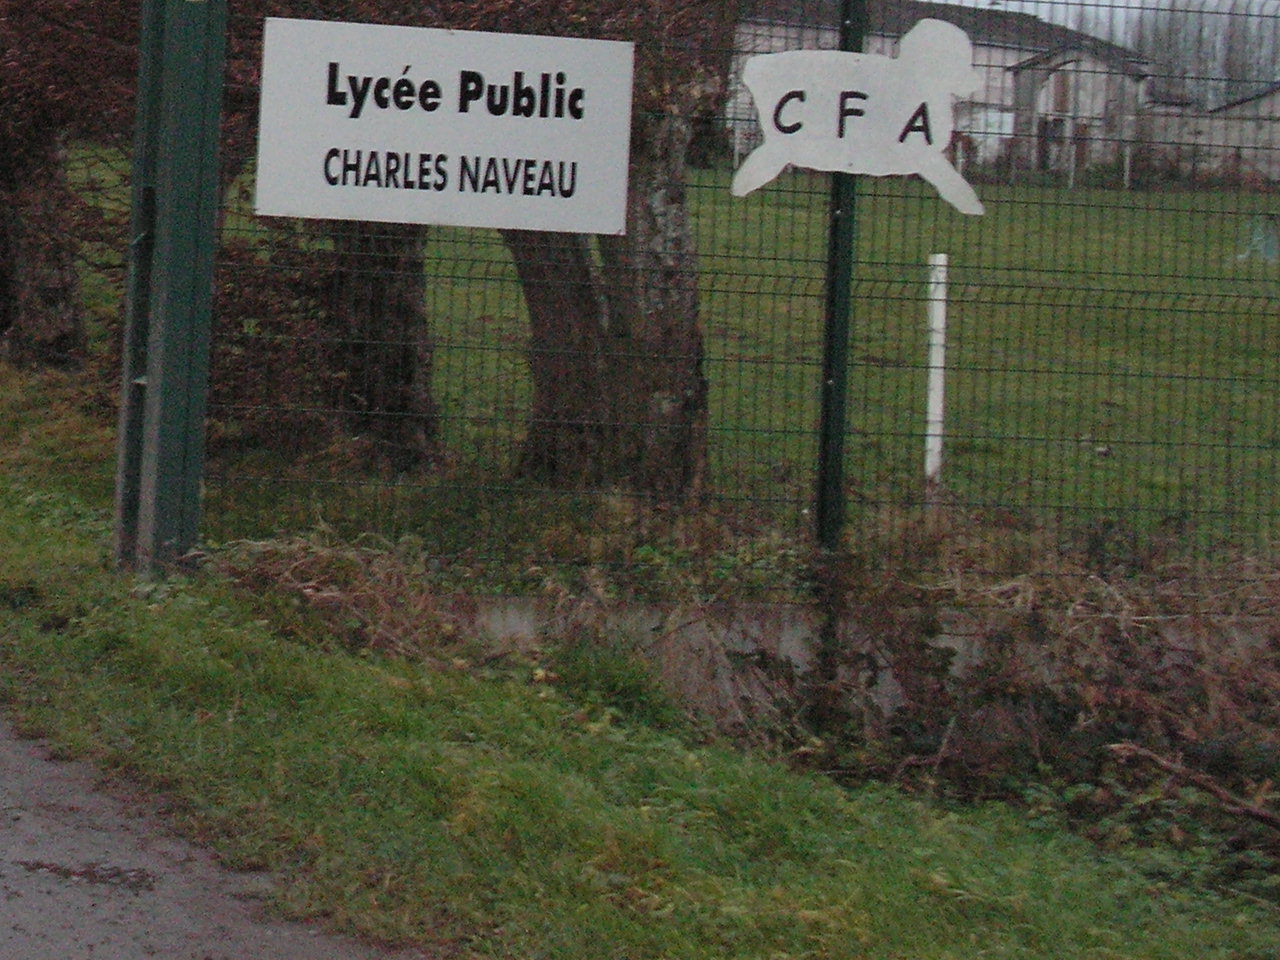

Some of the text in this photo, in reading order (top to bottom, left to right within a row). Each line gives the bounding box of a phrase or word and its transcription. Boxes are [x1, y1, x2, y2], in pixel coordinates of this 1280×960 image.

[325, 61, 587, 121] Lycée Public
[323, 147, 578, 199] CHARLES NAVEAU
